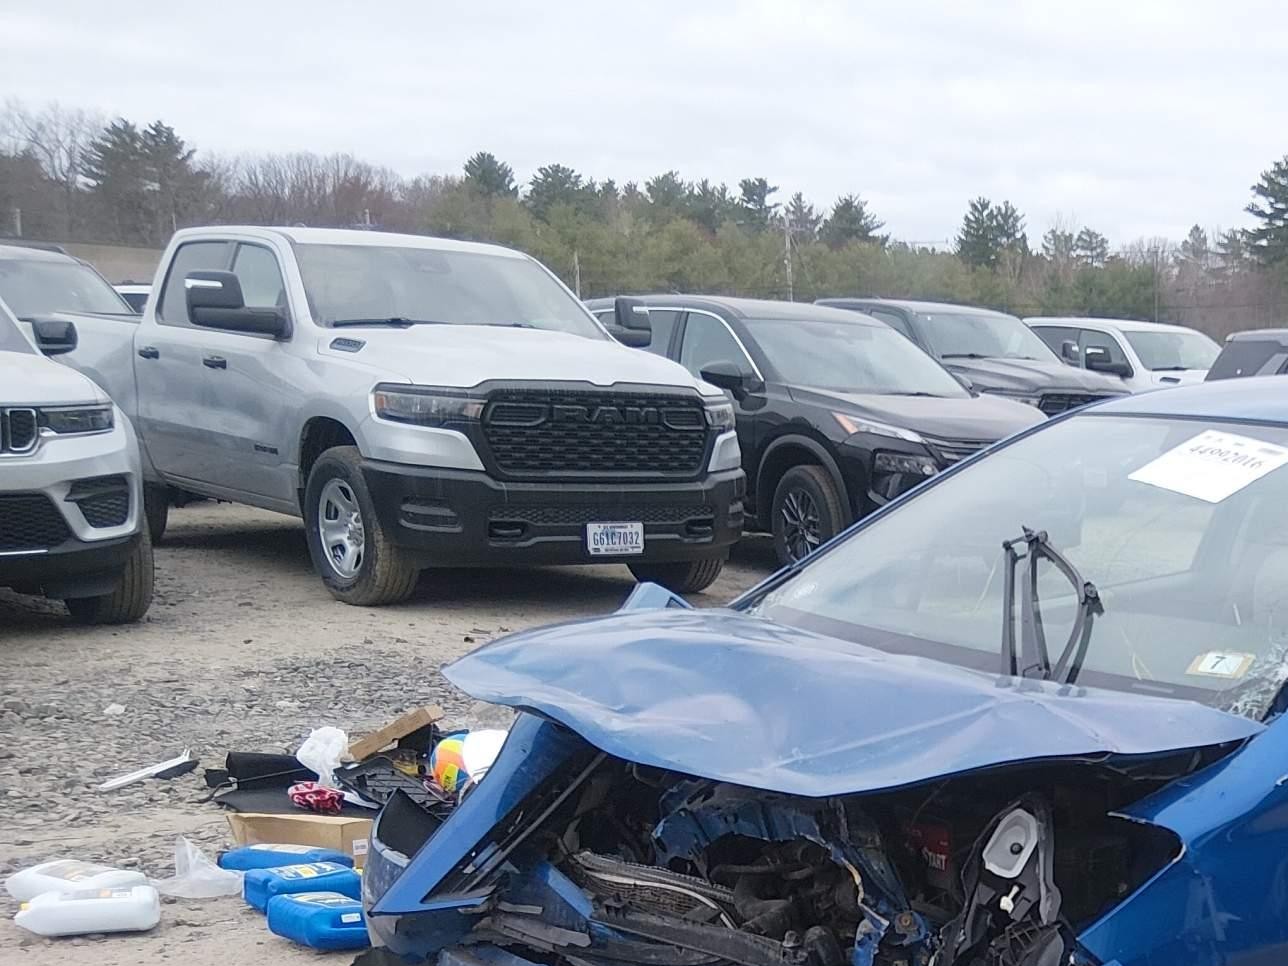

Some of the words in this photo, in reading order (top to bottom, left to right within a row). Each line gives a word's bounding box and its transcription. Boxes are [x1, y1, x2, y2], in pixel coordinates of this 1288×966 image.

[552, 404, 660, 425] RAM
[593, 531, 641, 546] G61C7032
[1210, 655, 1227, 670] 7
